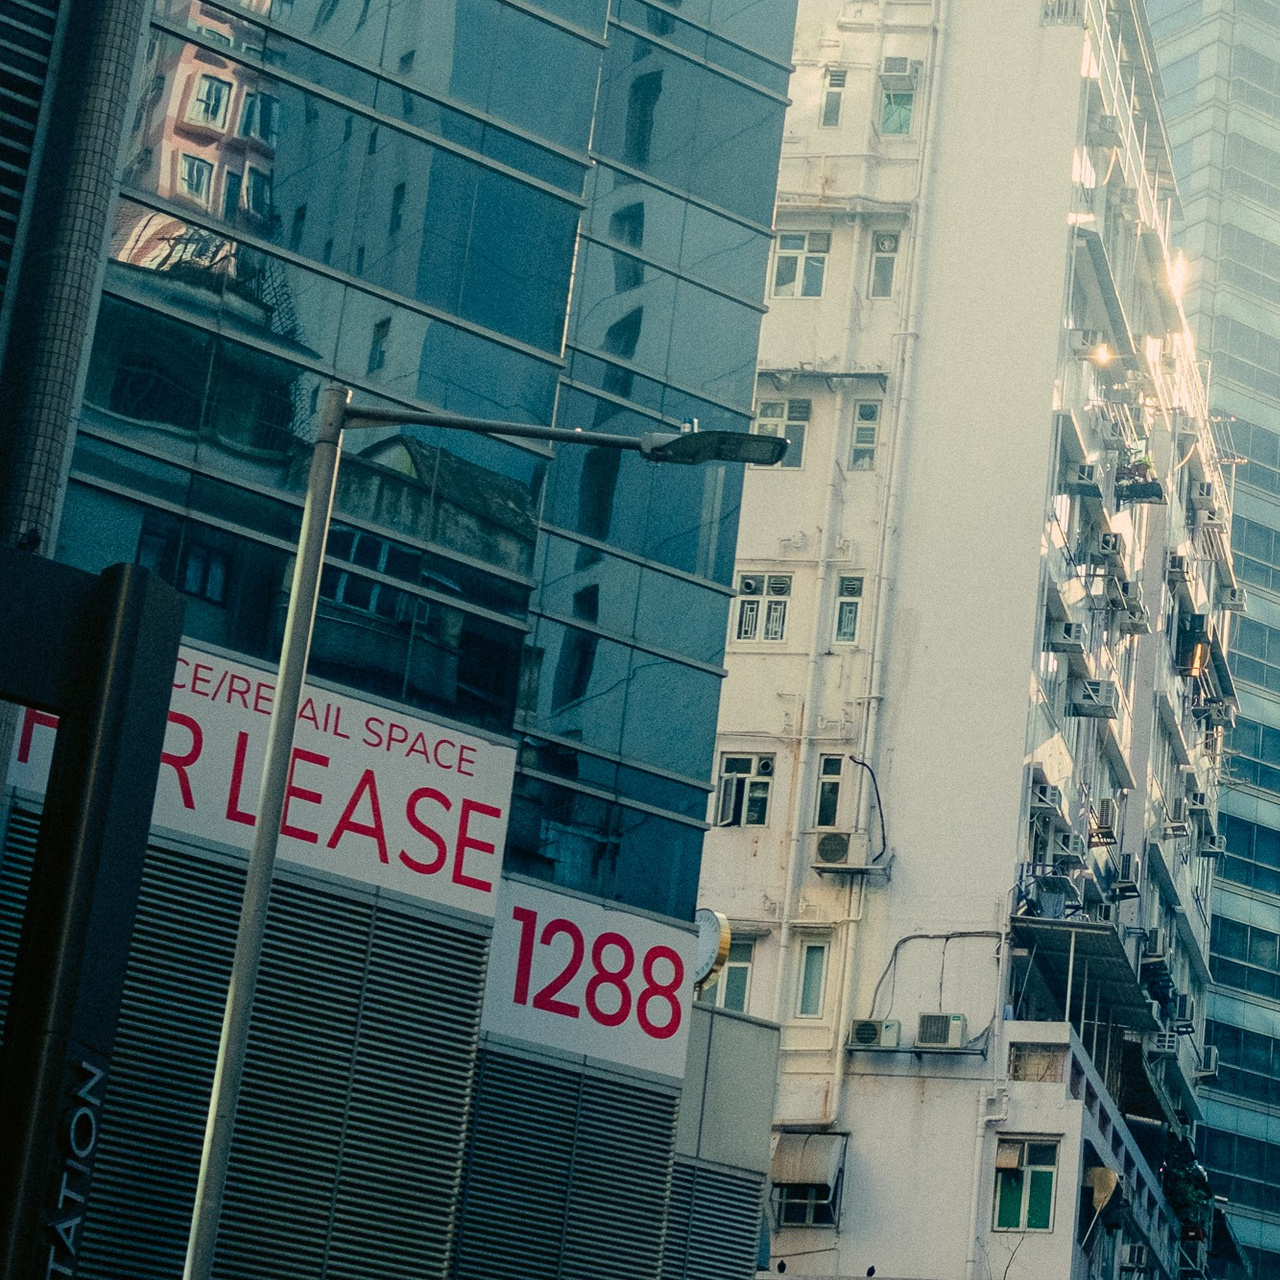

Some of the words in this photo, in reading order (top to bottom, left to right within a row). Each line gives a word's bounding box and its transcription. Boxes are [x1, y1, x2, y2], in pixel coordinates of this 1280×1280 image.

[172, 657, 350, 739] CE/REAIL
[362, 716, 478, 777] SPACE
[225, 730, 502, 893] LEASE
[512, 905, 685, 1040] 1288
